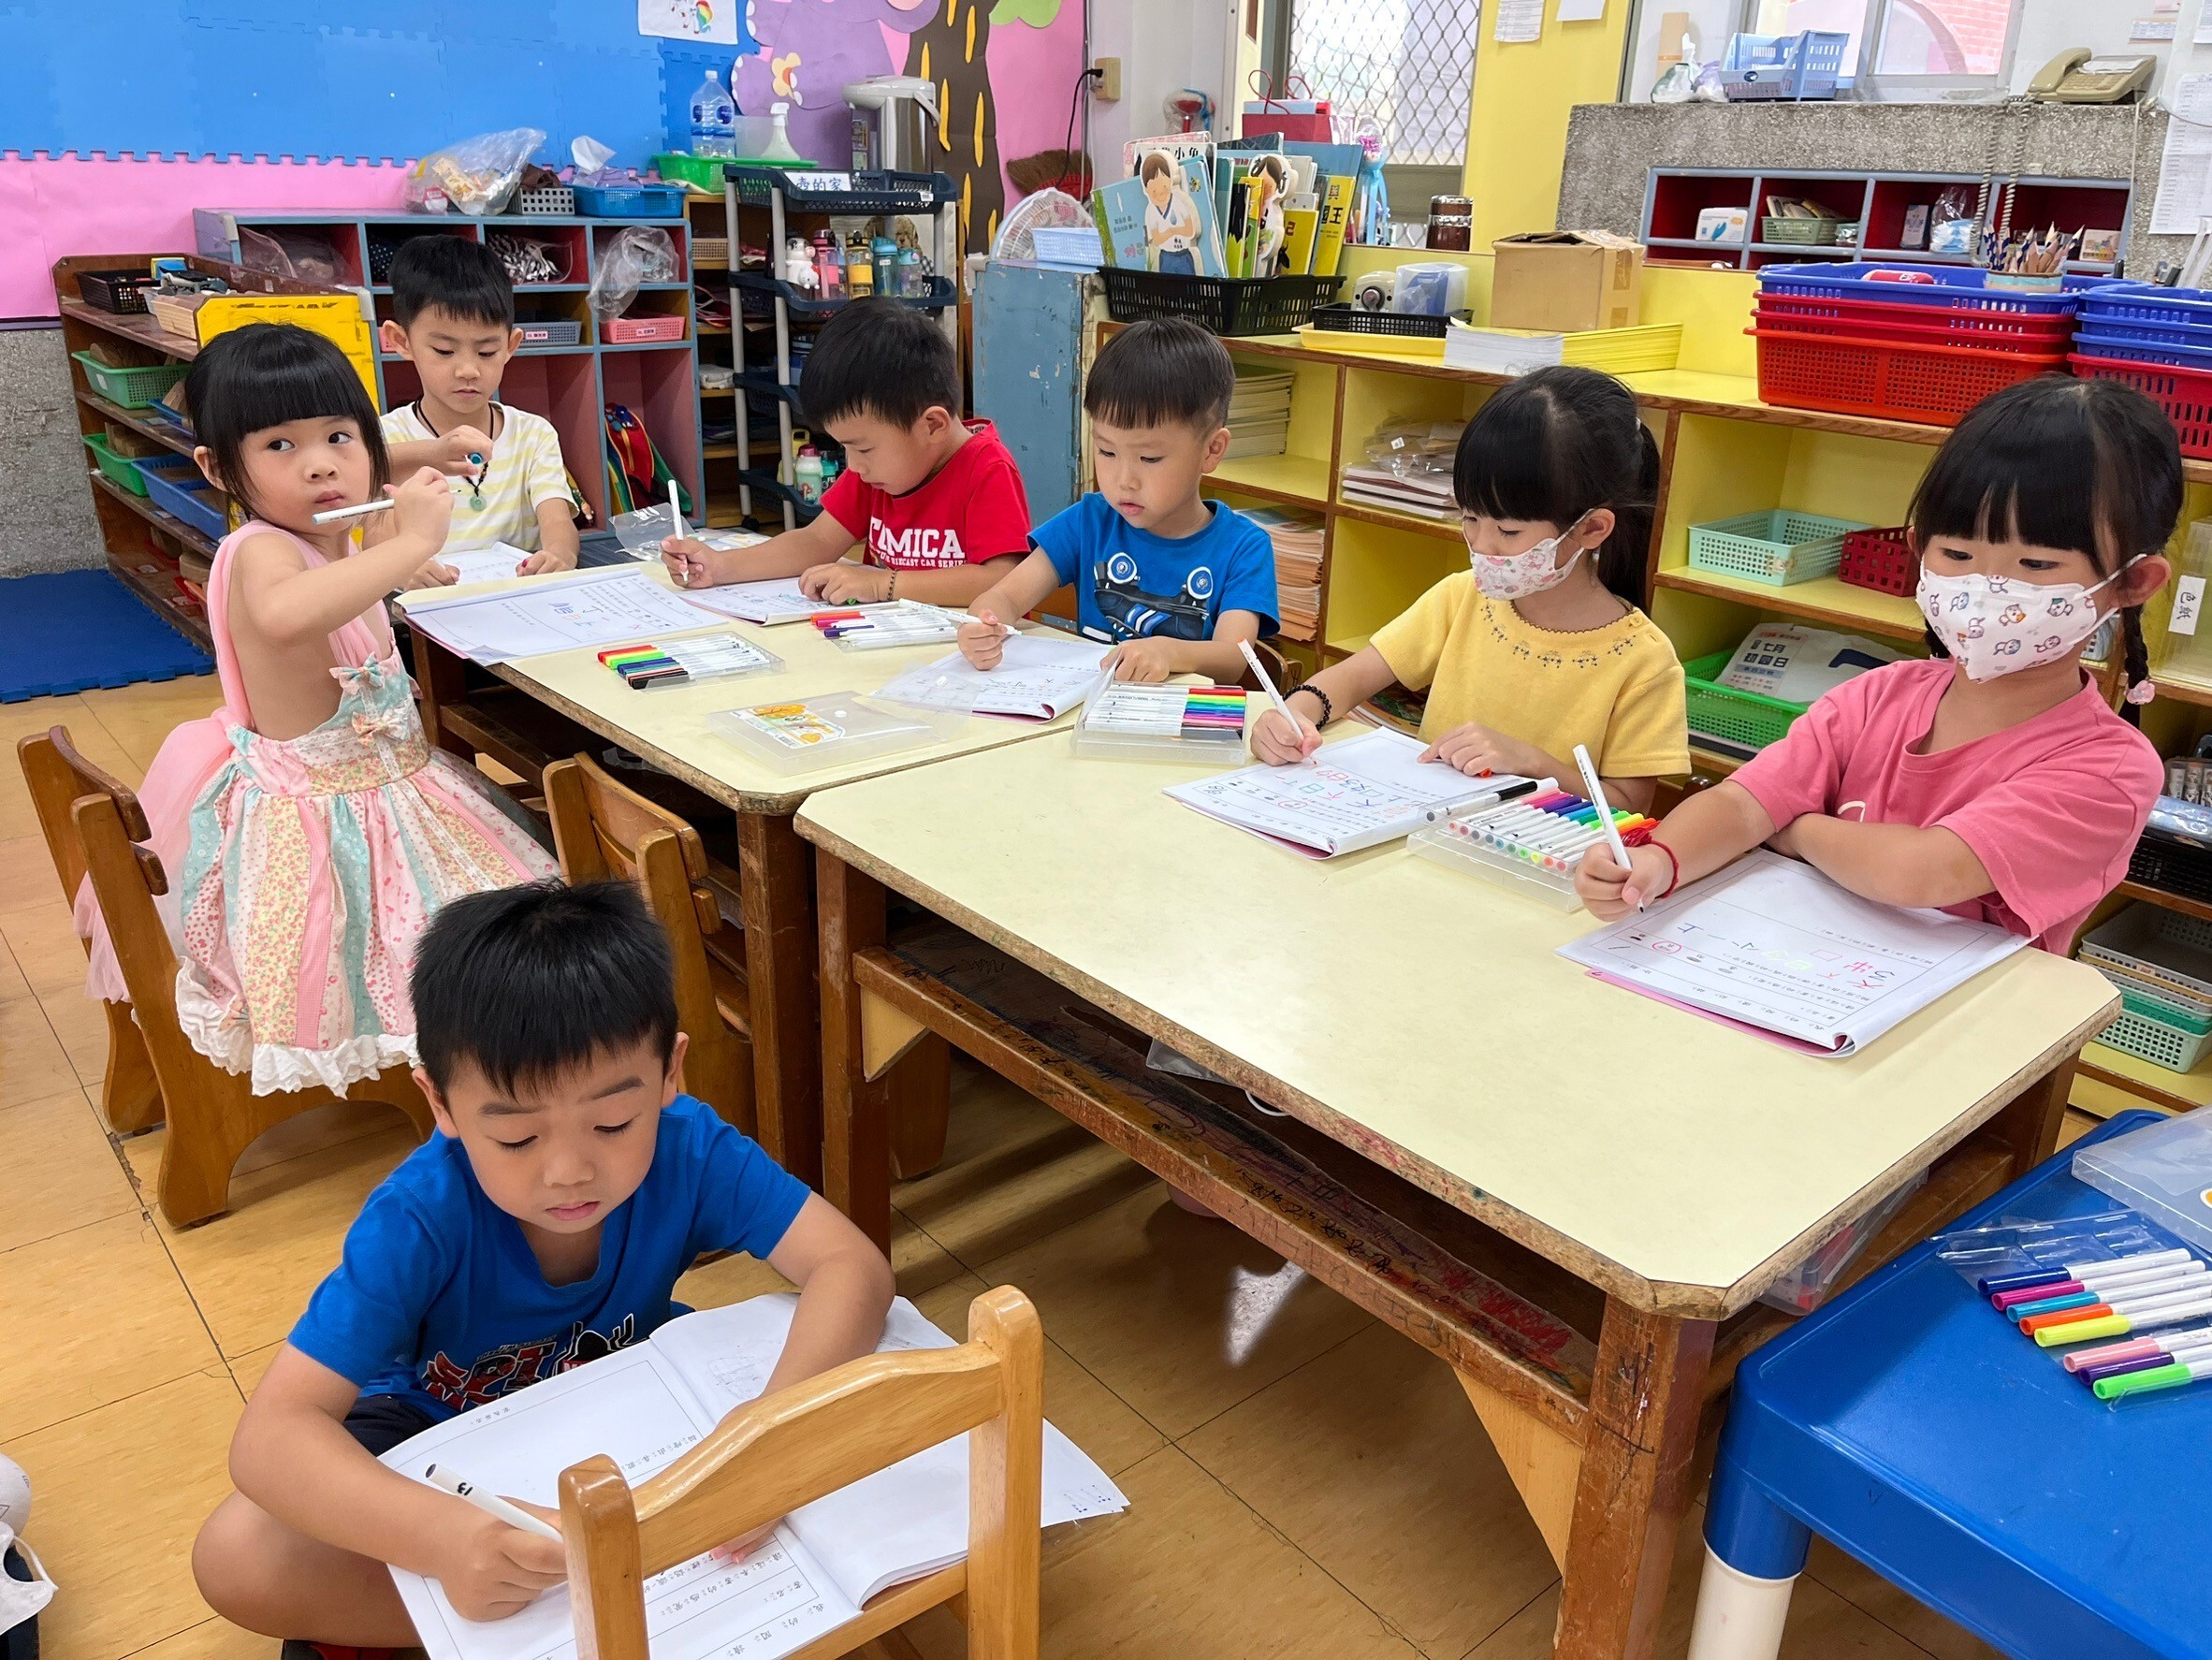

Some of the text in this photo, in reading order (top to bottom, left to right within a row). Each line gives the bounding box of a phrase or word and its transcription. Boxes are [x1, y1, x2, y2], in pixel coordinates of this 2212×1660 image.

[921, 559, 937, 567] CAR
[938, 560, 966, 568] SERIE
[456, 1480, 473, 1496] 13
